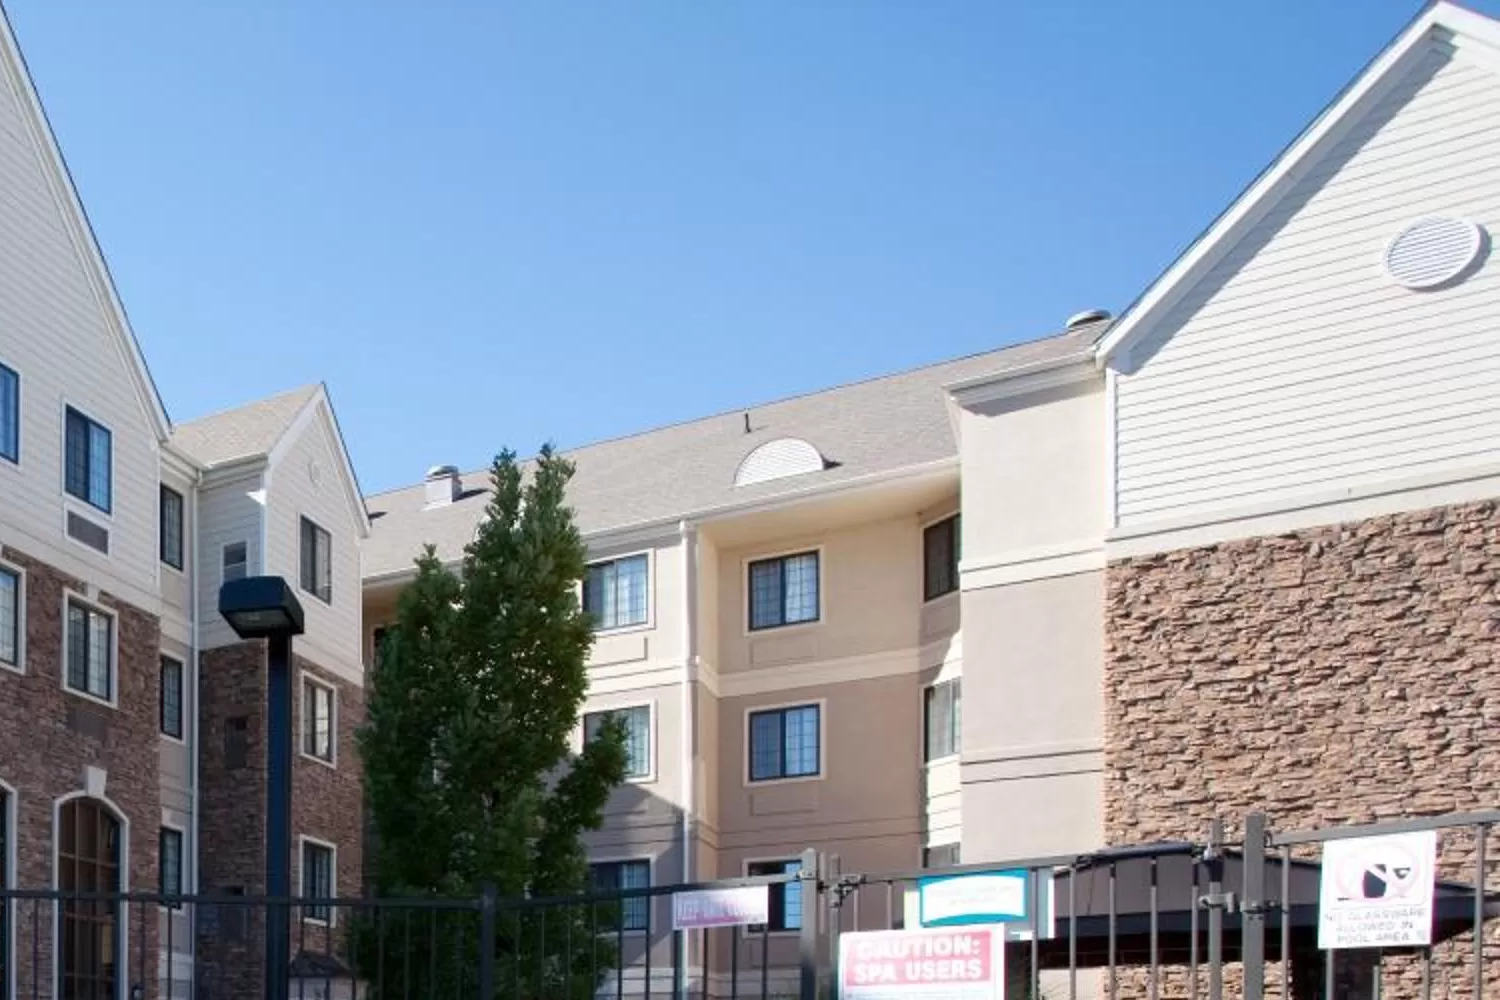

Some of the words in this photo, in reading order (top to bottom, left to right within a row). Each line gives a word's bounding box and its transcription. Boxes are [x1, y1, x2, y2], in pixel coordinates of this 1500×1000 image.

[856, 934, 981, 959] CAUTION:
[1375, 930, 1411, 943] AREA
[853, 961, 898, 984] SPA
[905, 957, 983, 981] USERS
